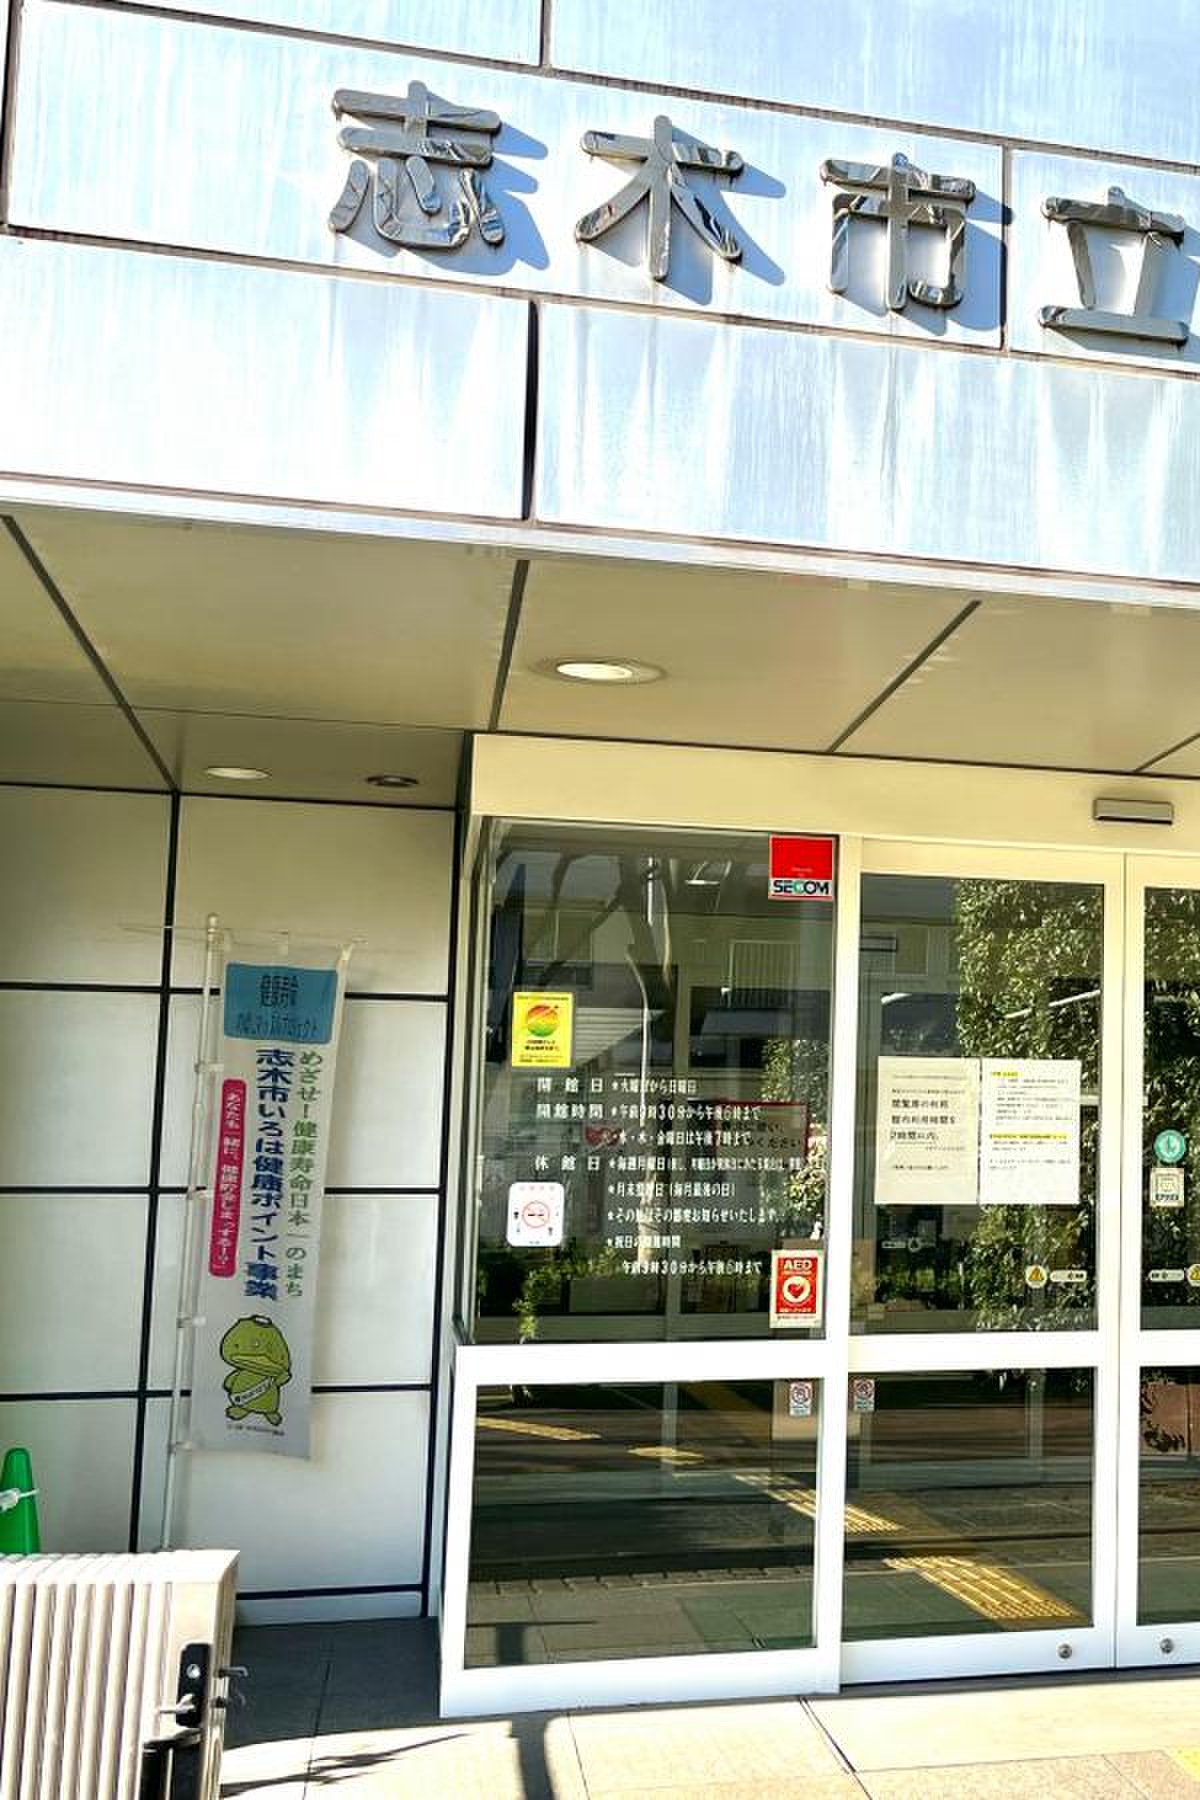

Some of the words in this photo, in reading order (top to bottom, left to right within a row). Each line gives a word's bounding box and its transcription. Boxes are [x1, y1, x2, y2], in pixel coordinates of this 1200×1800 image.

[774, 880, 829, 895] SECOM
[244, 1048, 296, 1300] 志木市いろは健康ポイント事業
[783, 1259, 812, 1271] AED
